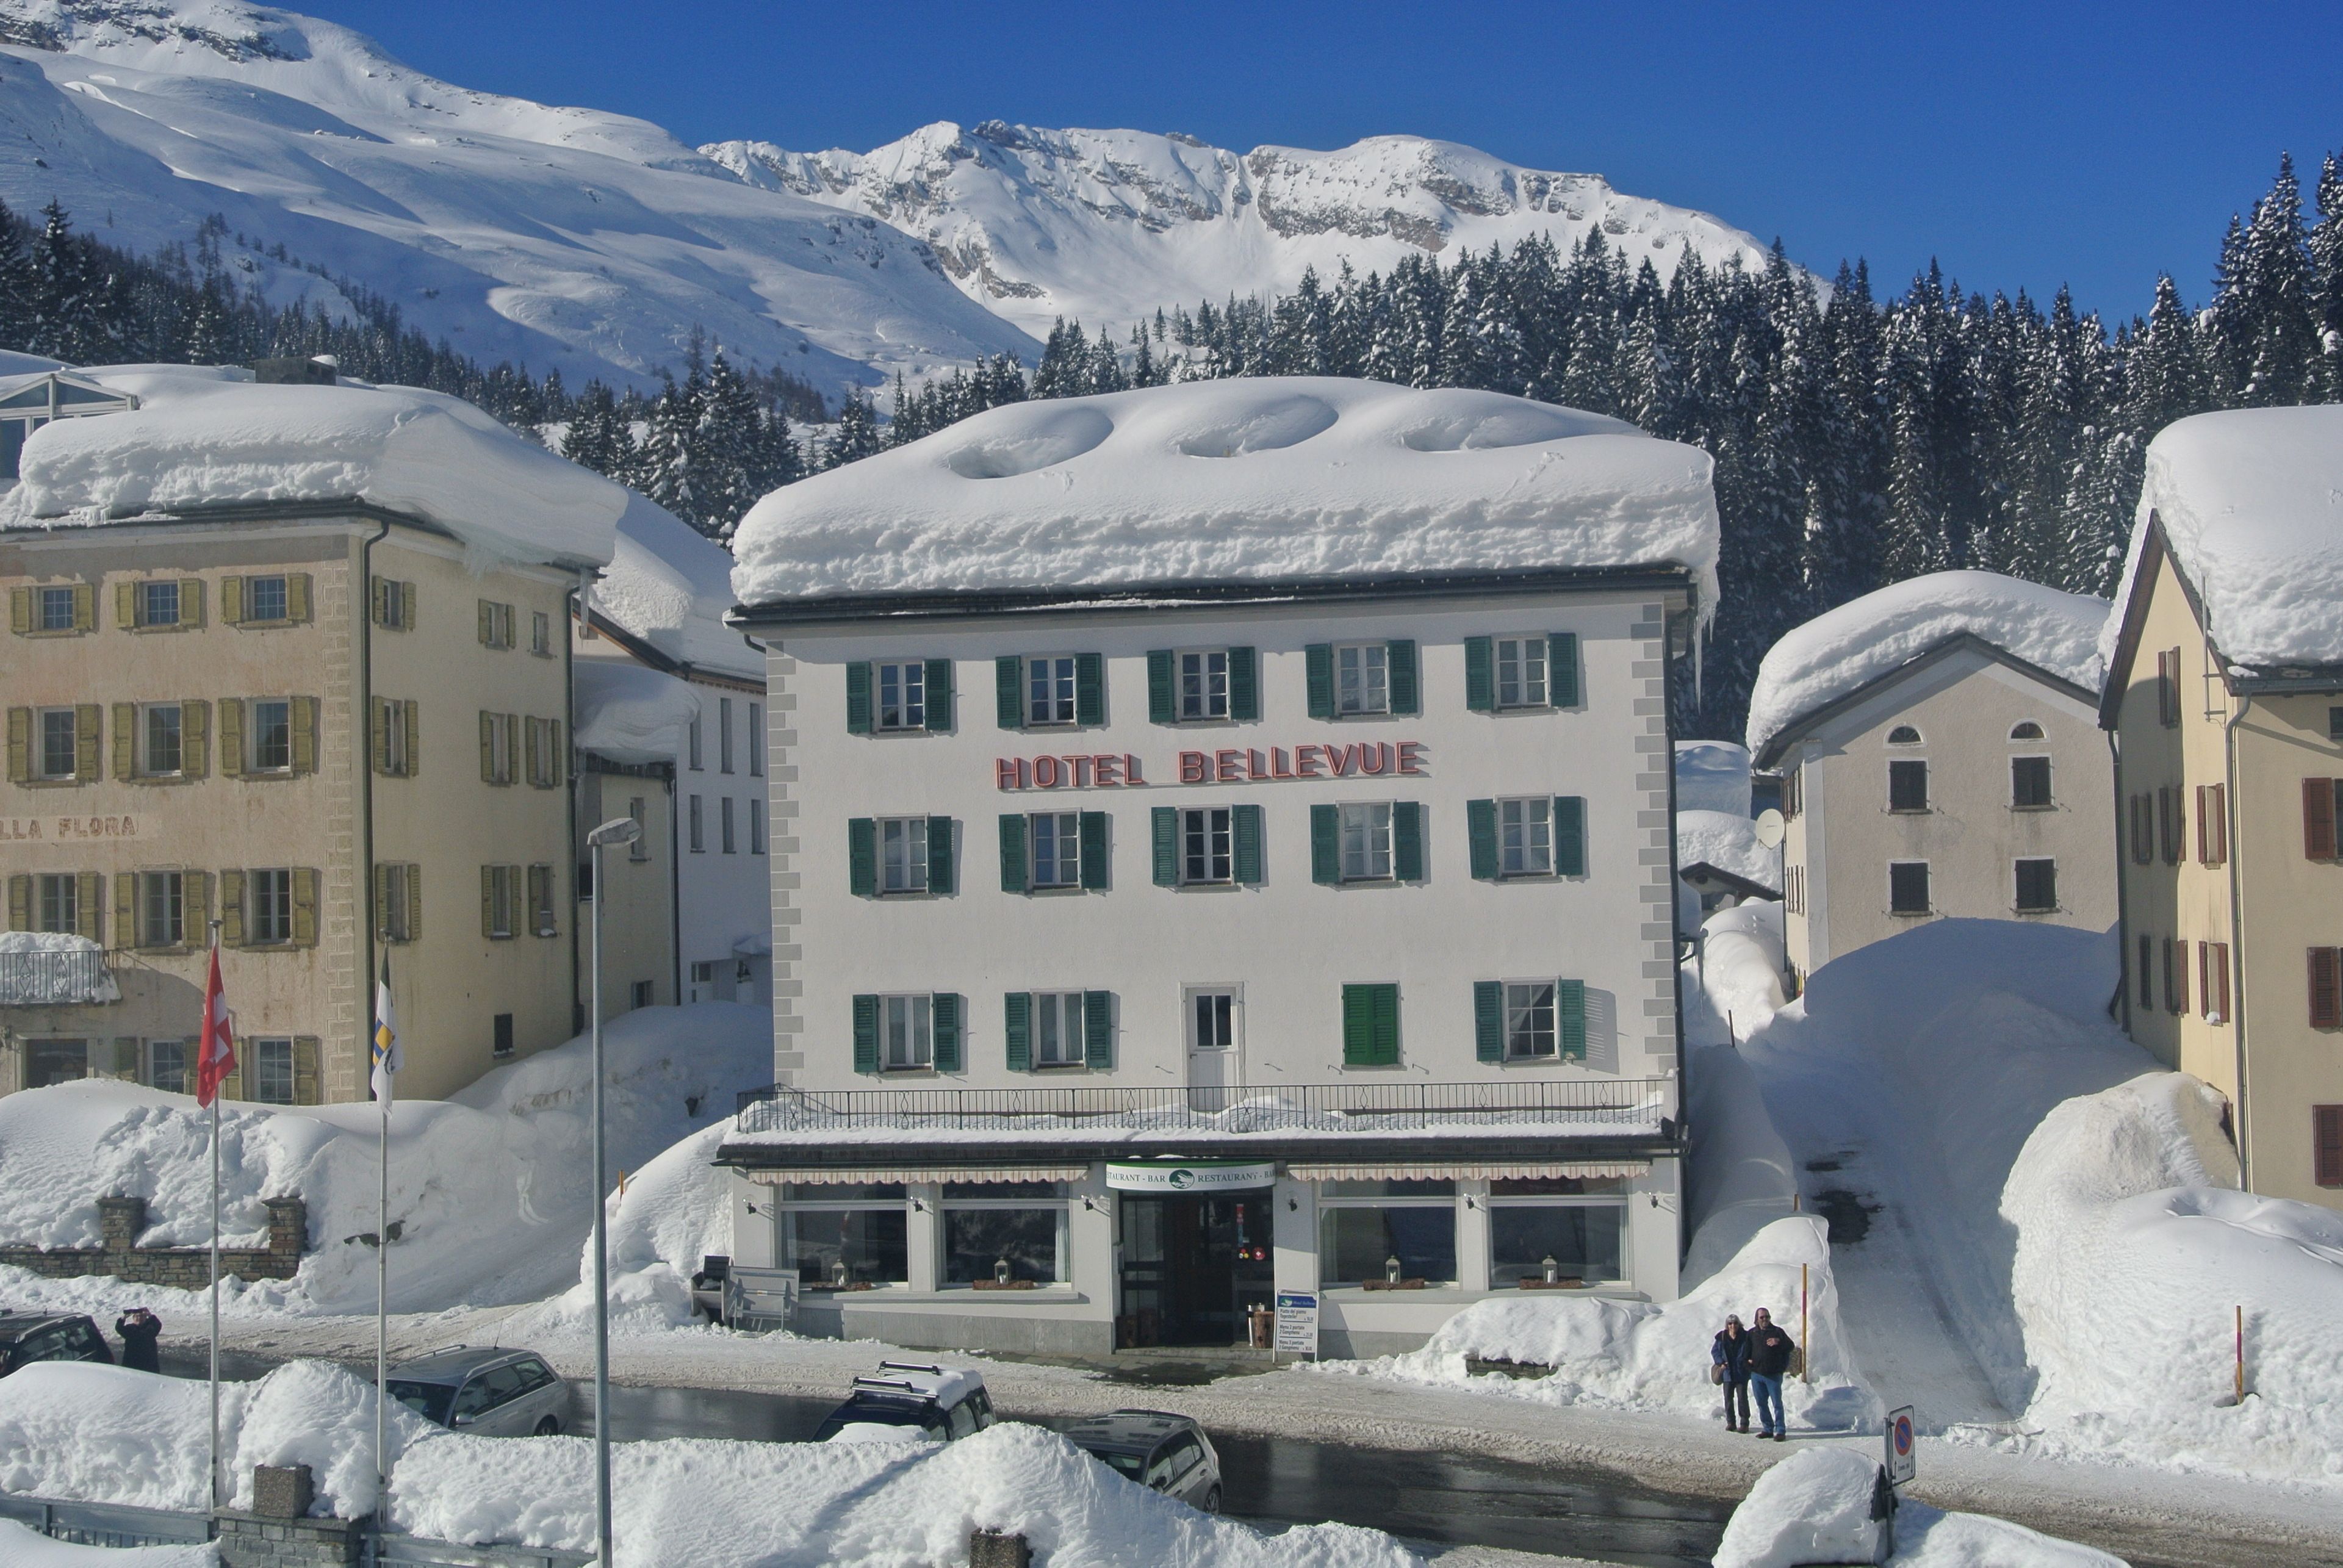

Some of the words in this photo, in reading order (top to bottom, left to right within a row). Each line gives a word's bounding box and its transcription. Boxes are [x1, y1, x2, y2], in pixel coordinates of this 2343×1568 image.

[996, 753, 1143, 789] HOTEL
[1178, 741, 1419, 783] BELLEVUE
[58, 816, 135, 838] FLORA
[1198, 1171, 1258, 1182] RESTAURANT
